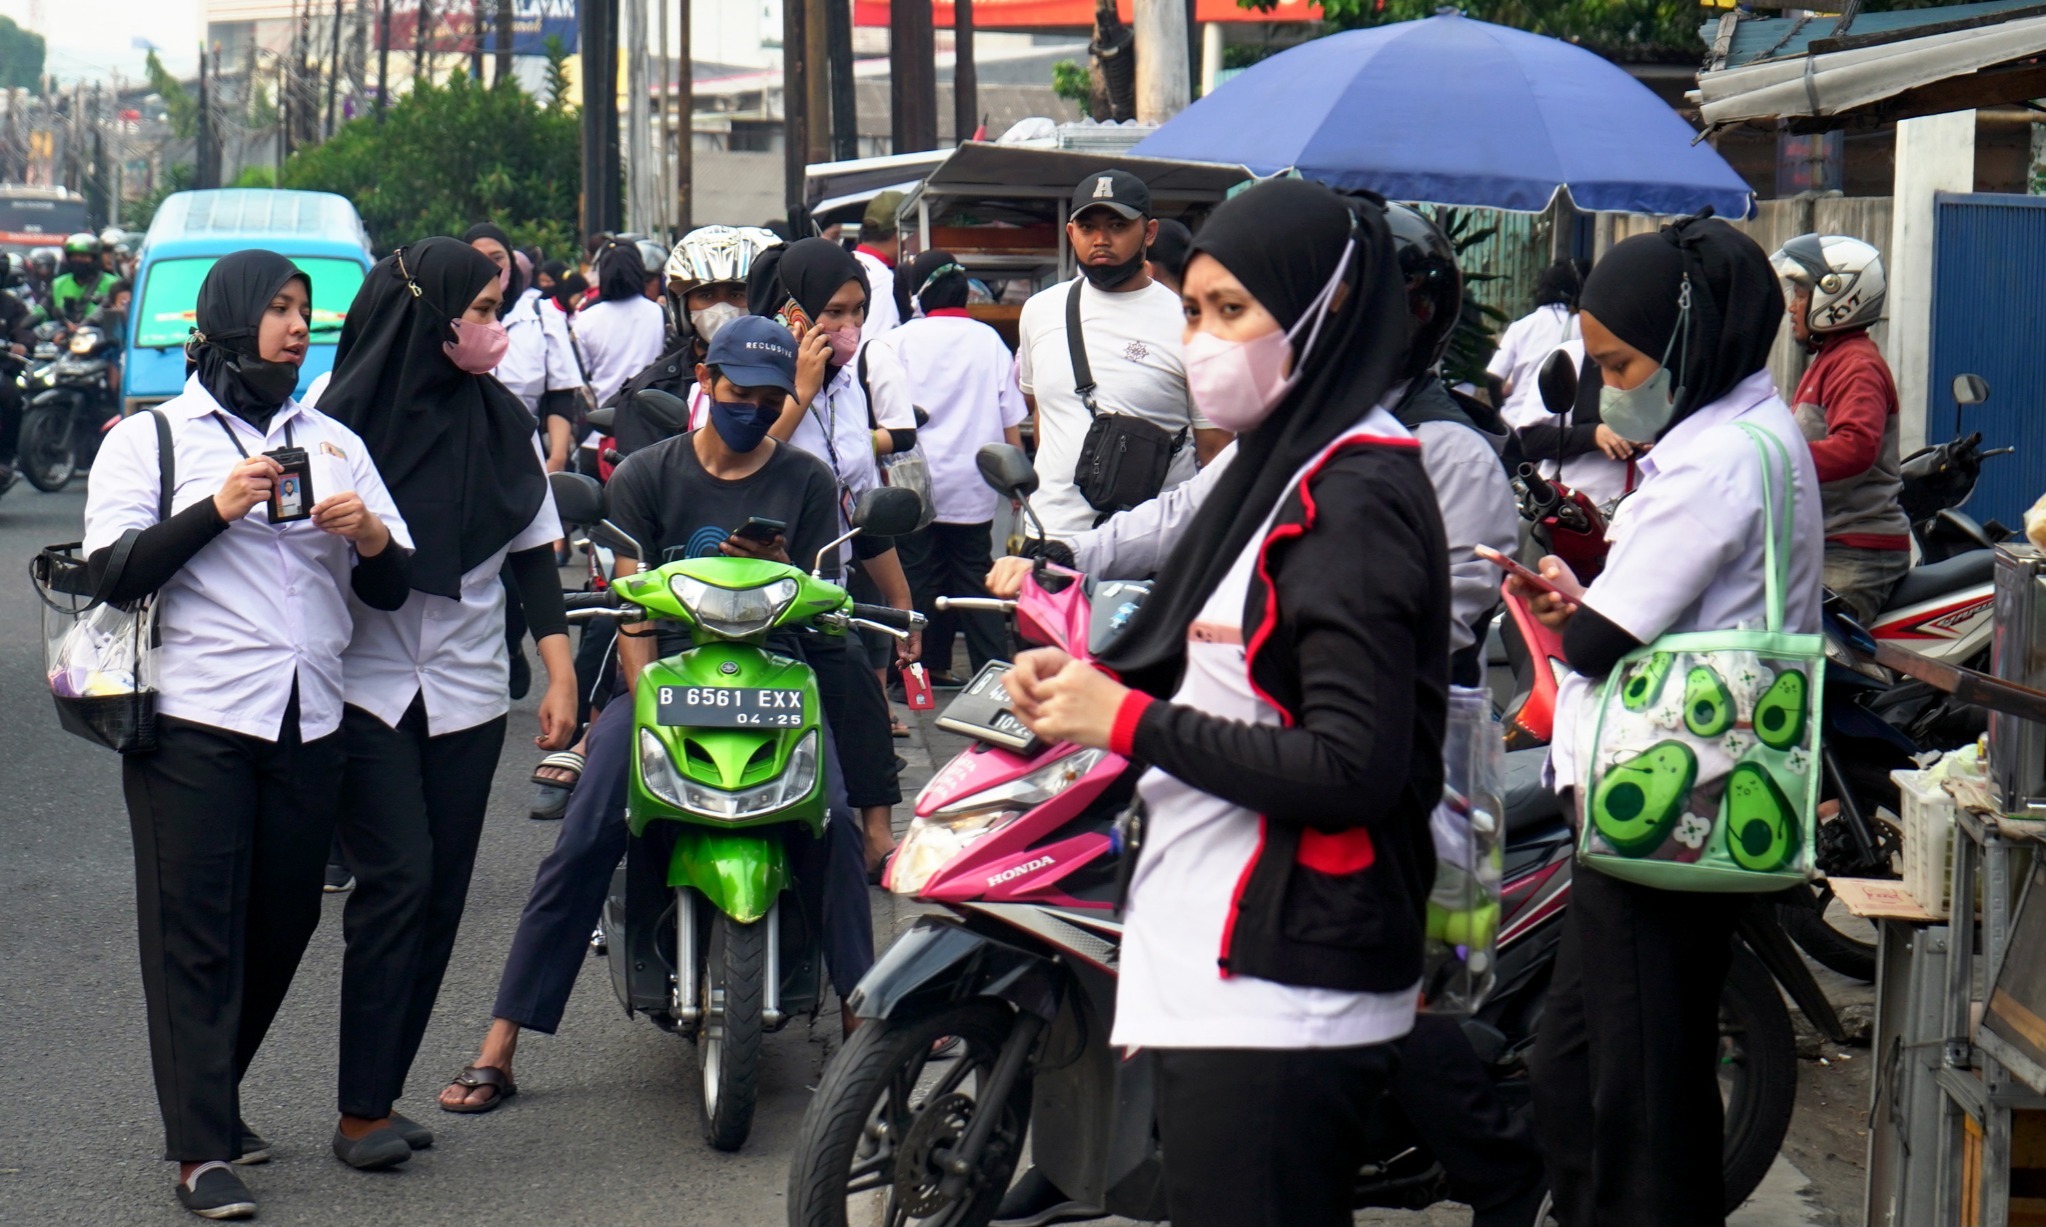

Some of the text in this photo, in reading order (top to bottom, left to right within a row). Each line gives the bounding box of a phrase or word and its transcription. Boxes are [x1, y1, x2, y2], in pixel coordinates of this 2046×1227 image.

[1092, 176, 1114, 198] A
[1826, 288, 1862, 326] KYT
[970, 672, 994, 695] B
[660, 687, 801, 708] B 6561 EXX
[986, 855, 1056, 887] HONDA
